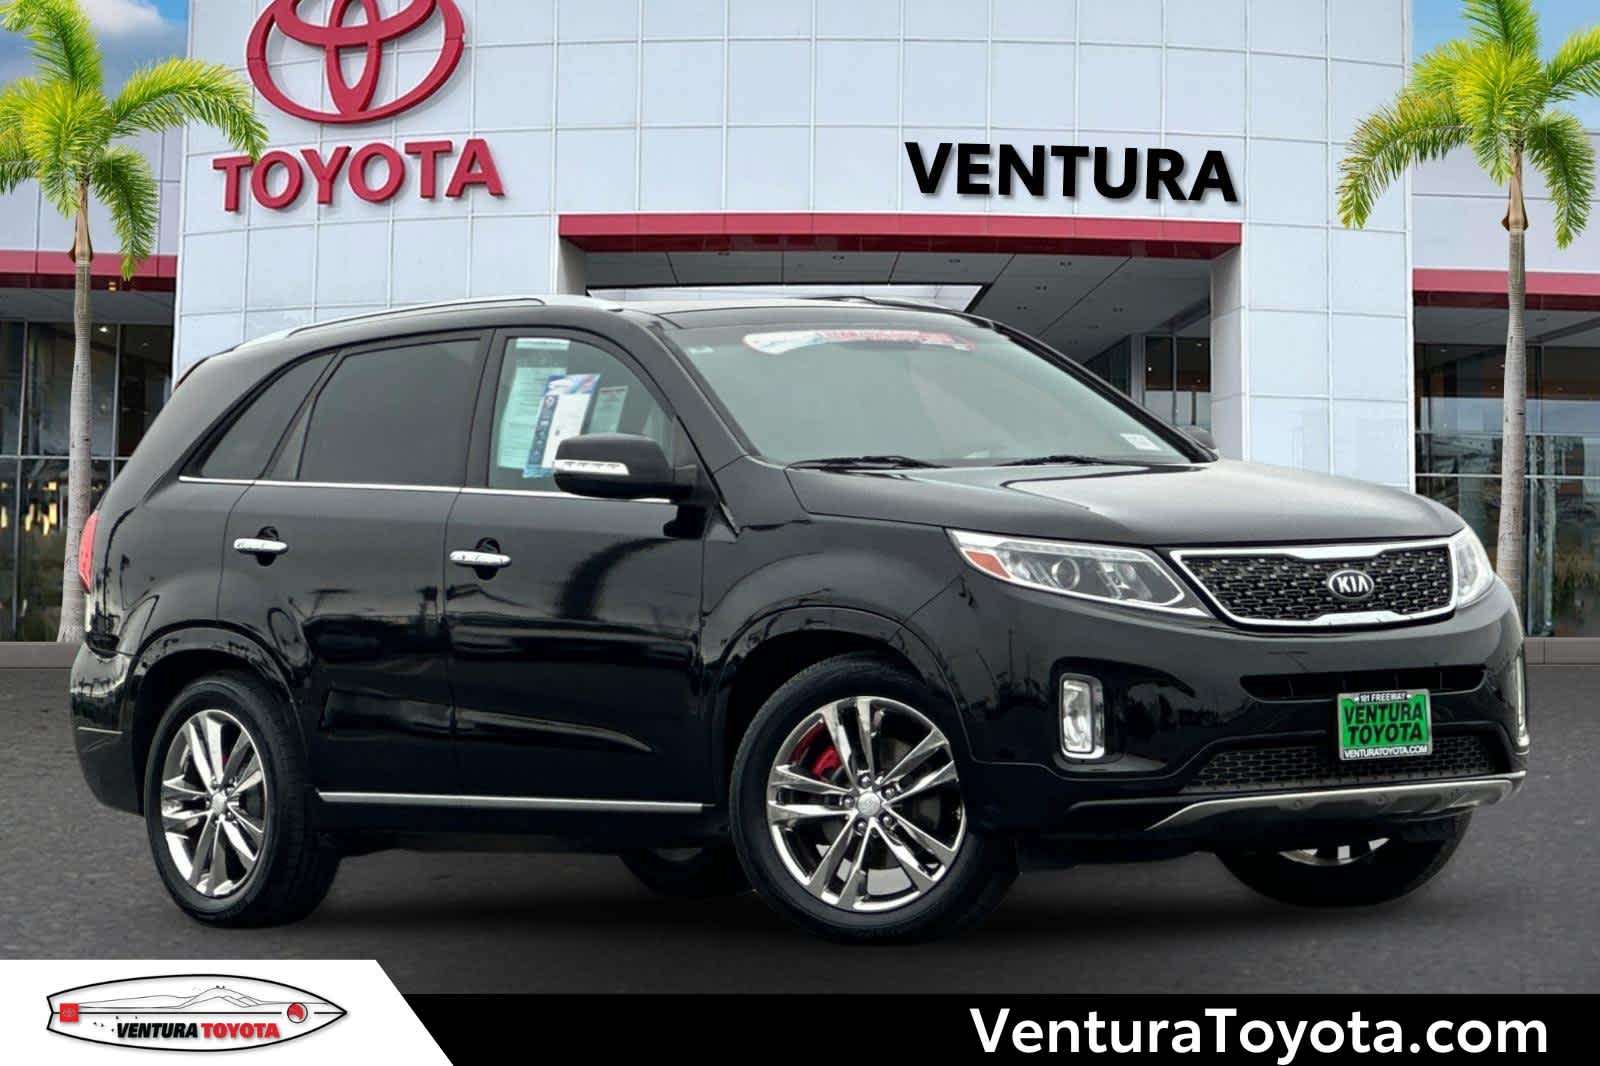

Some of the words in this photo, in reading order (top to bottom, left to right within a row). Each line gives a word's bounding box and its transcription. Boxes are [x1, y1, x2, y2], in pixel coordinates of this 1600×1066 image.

[213, 138, 505, 212] TOYOTA
[904, 142, 1238, 202] VENTURA
[1336, 575, 1369, 593] KIA
[1371, 693, 1406, 701] FREEWAY
[1343, 702, 1424, 724] VENTURA
[1347, 722, 1423, 745] TOYOTA
[1344, 745, 1428, 758] VENTURATOYOTA.COM
